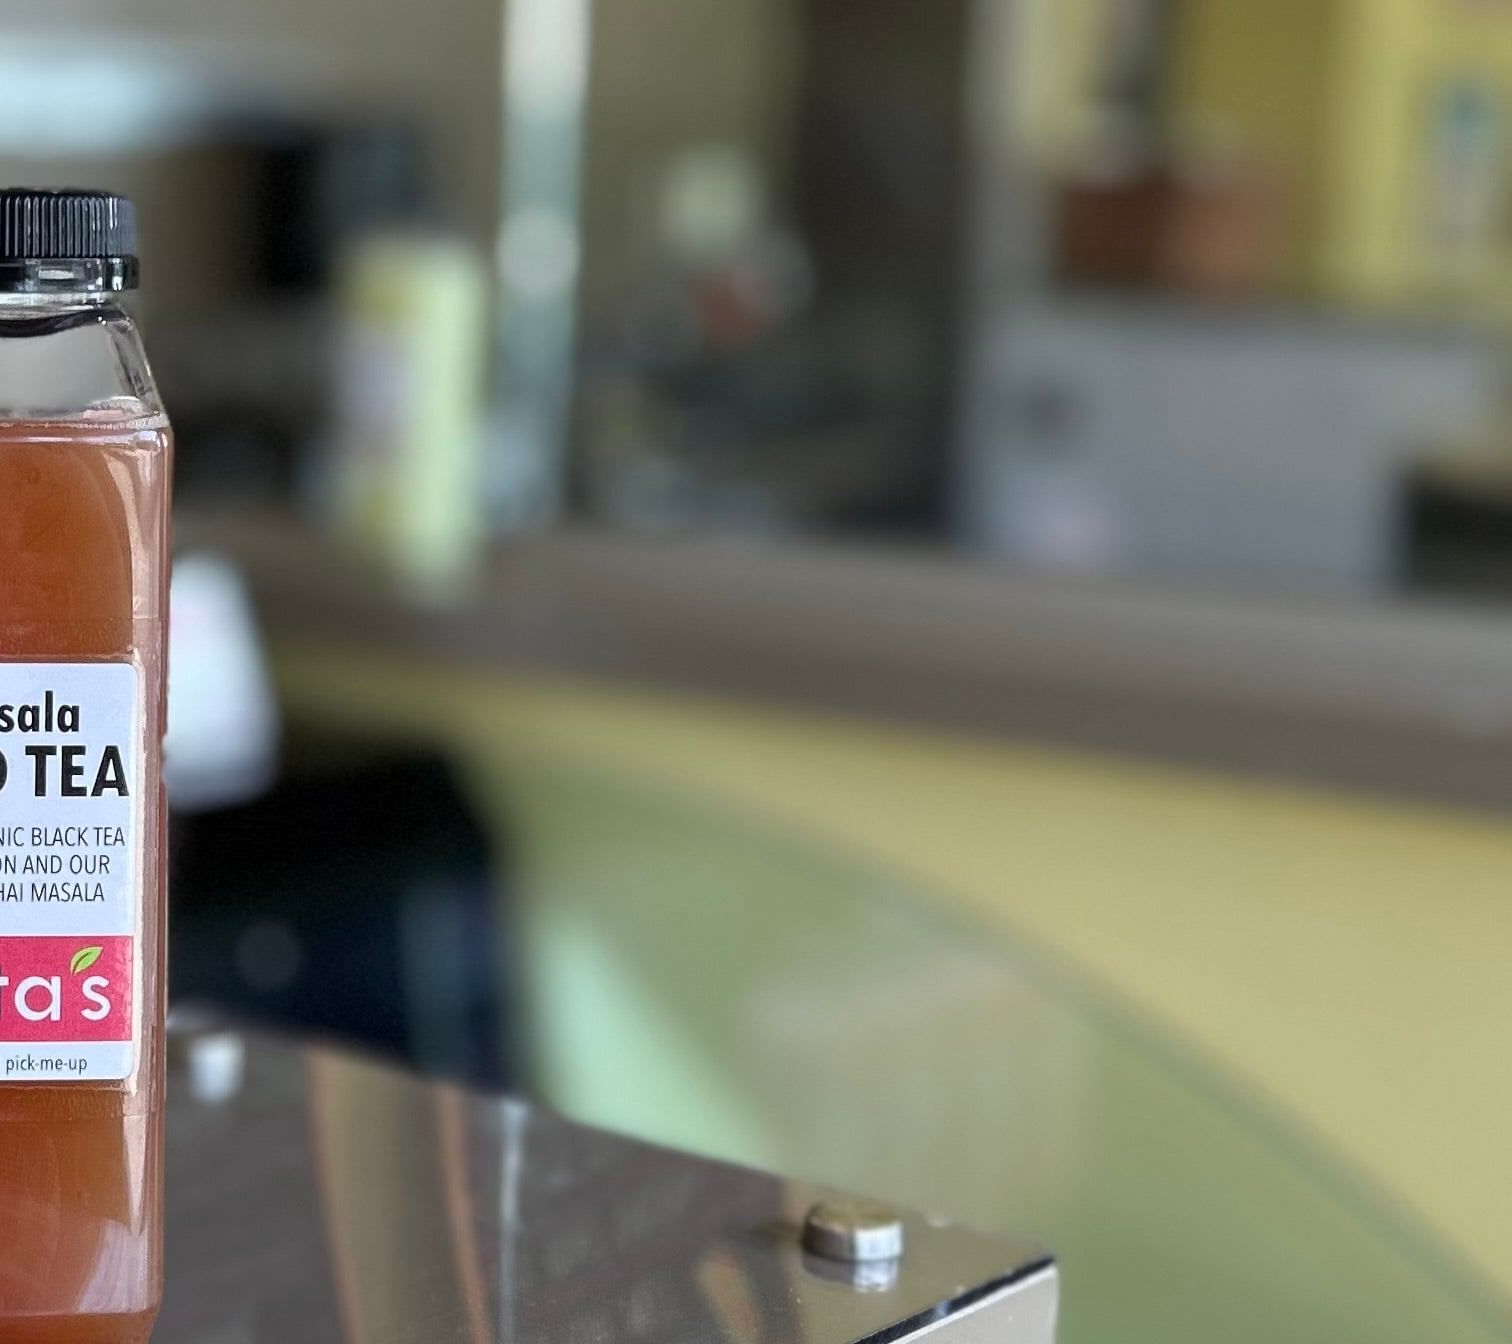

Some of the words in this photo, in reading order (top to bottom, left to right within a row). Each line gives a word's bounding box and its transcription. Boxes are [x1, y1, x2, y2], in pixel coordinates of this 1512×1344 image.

[25, 745, 129, 797] TEA
[32, 827, 88, 846] BLACK
[93, 827, 124, 846] TEA
[23, 855, 62, 874] AND
[70, 855, 109, 874] OUR
[32, 882, 104, 902] MASALA
[7, 1055, 87, 1074] pick-me-up
